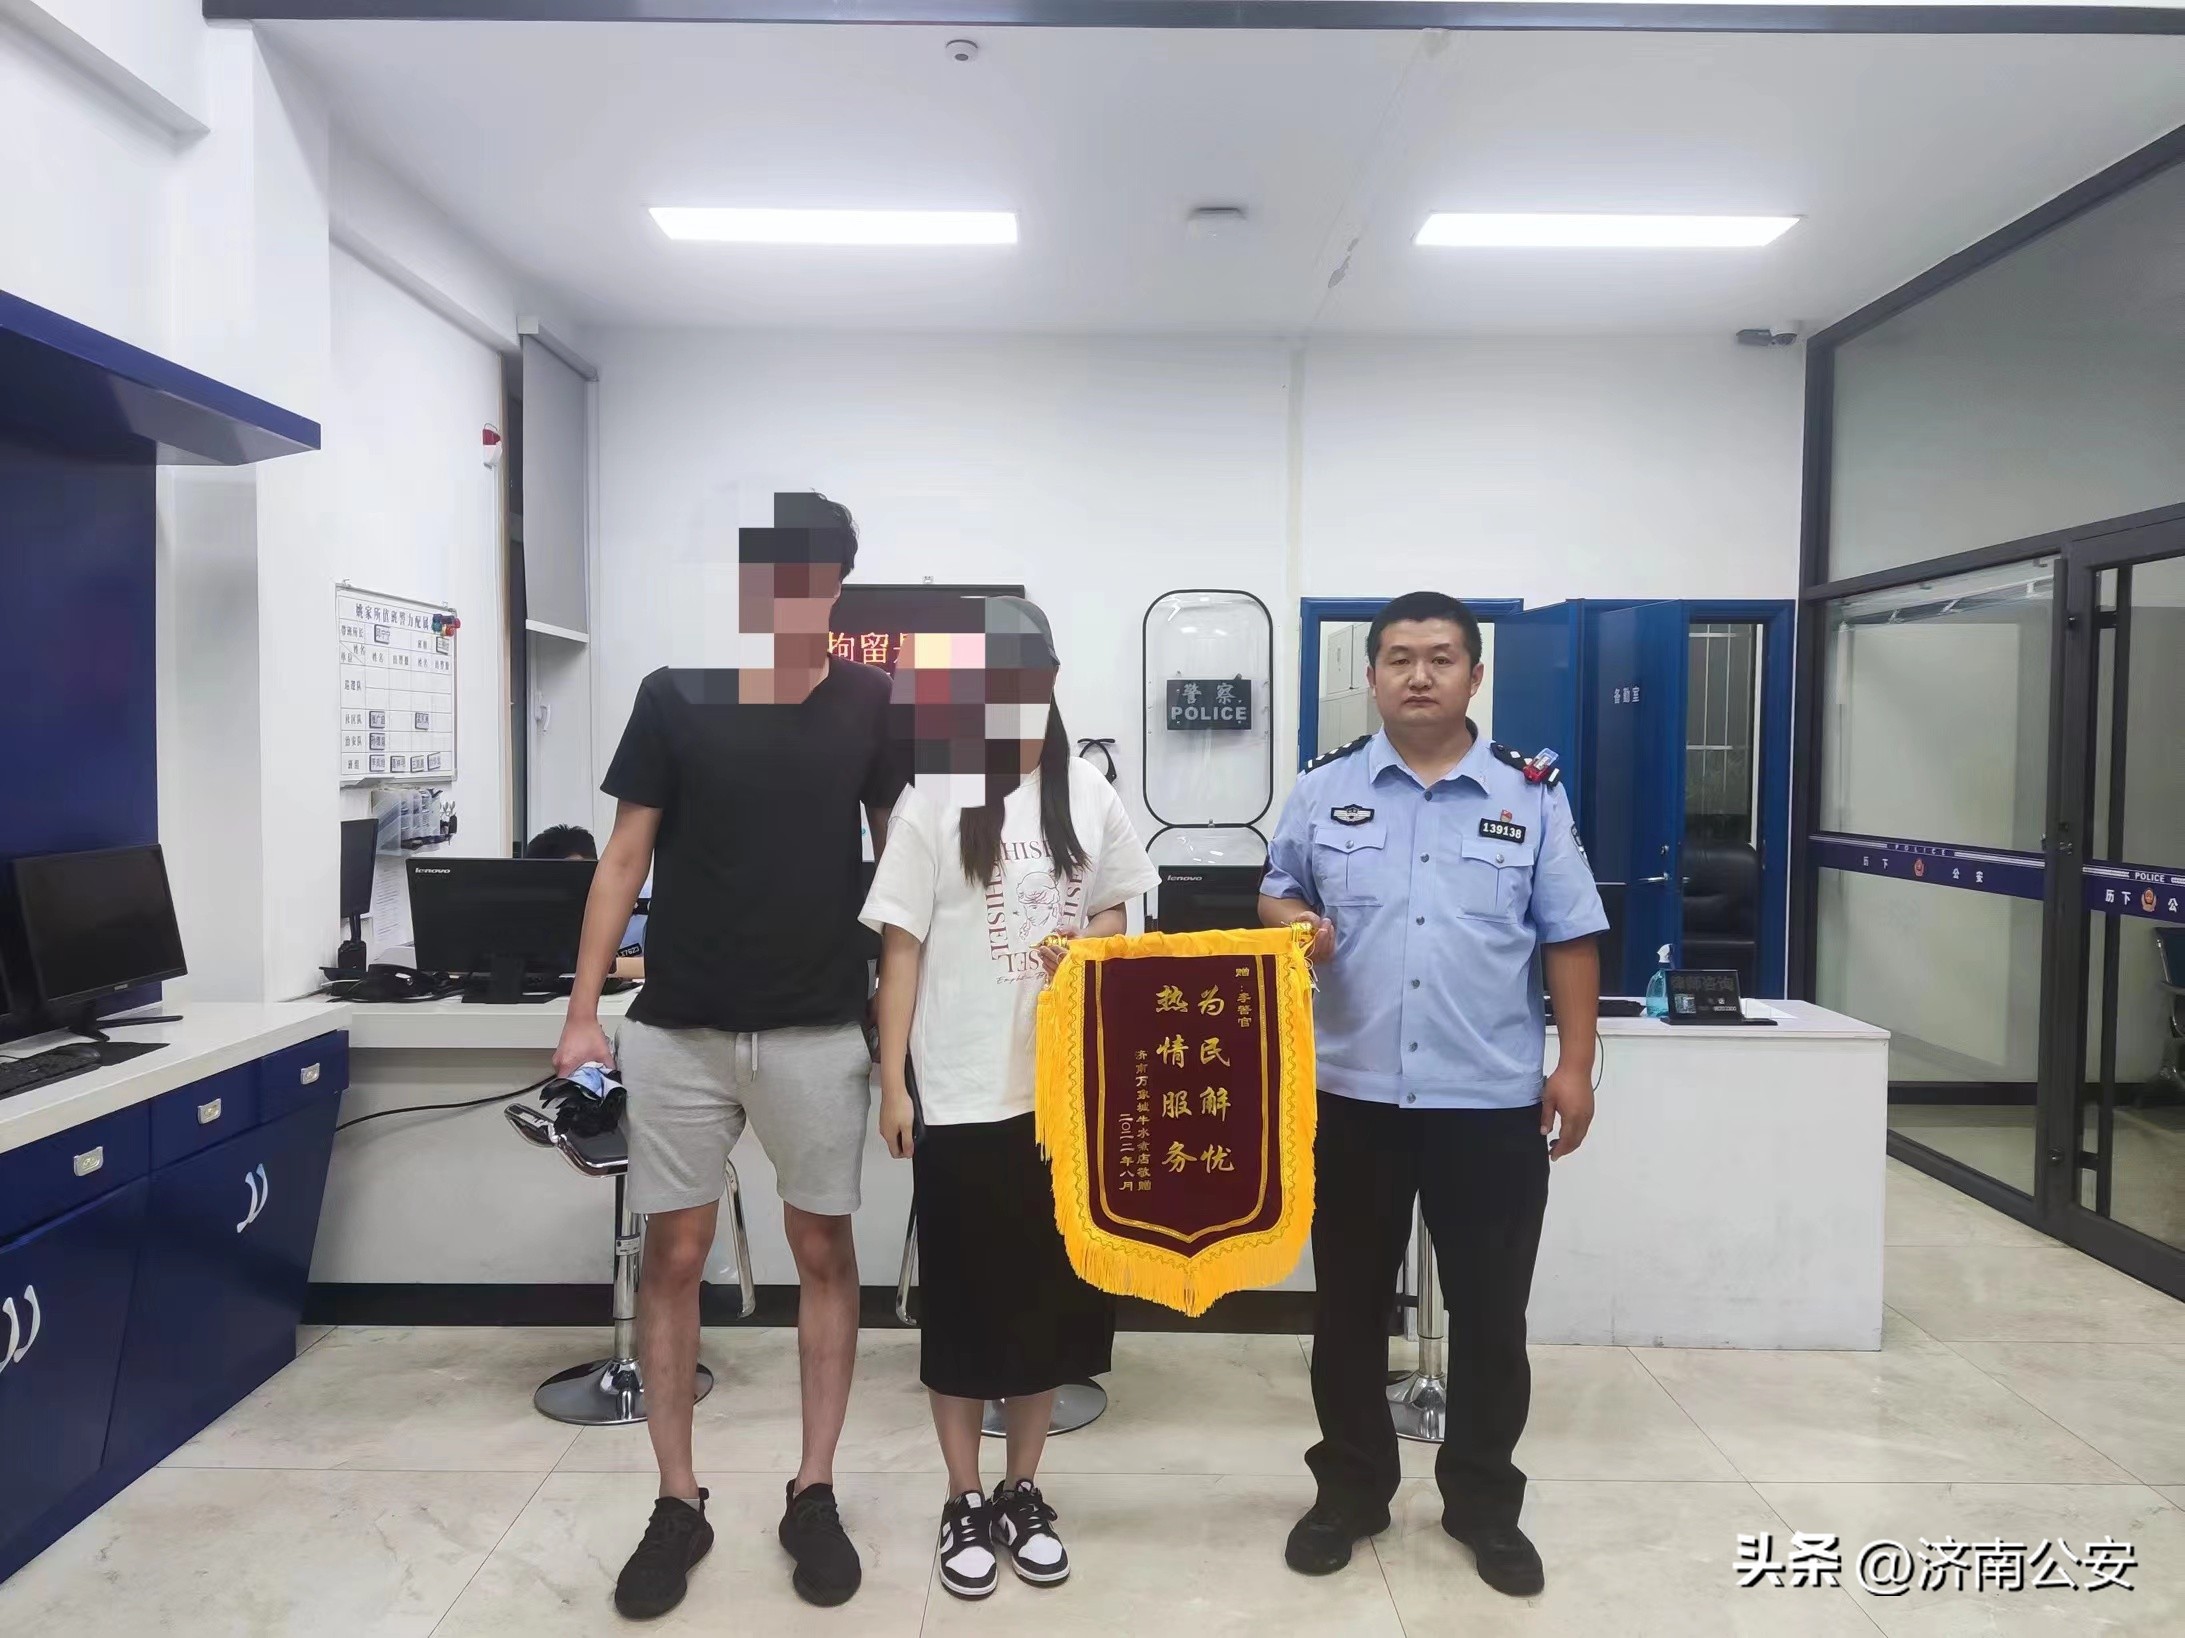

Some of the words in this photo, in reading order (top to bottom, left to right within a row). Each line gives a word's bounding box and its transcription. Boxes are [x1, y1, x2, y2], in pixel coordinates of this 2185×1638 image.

[1182, 682, 1236, 705] 警察
[1171, 706, 1248, 721] POLICE
[1482, 822, 1522, 839] 139138
[1894, 844, 1946, 856] POLICE
[1167, 874, 1203, 882] lenovo
[2134, 872, 2166, 883] POLICE
[1156, 984, 1198, 1173] 热情服务
[1198, 985, 1235, 1174] 为民解忧
